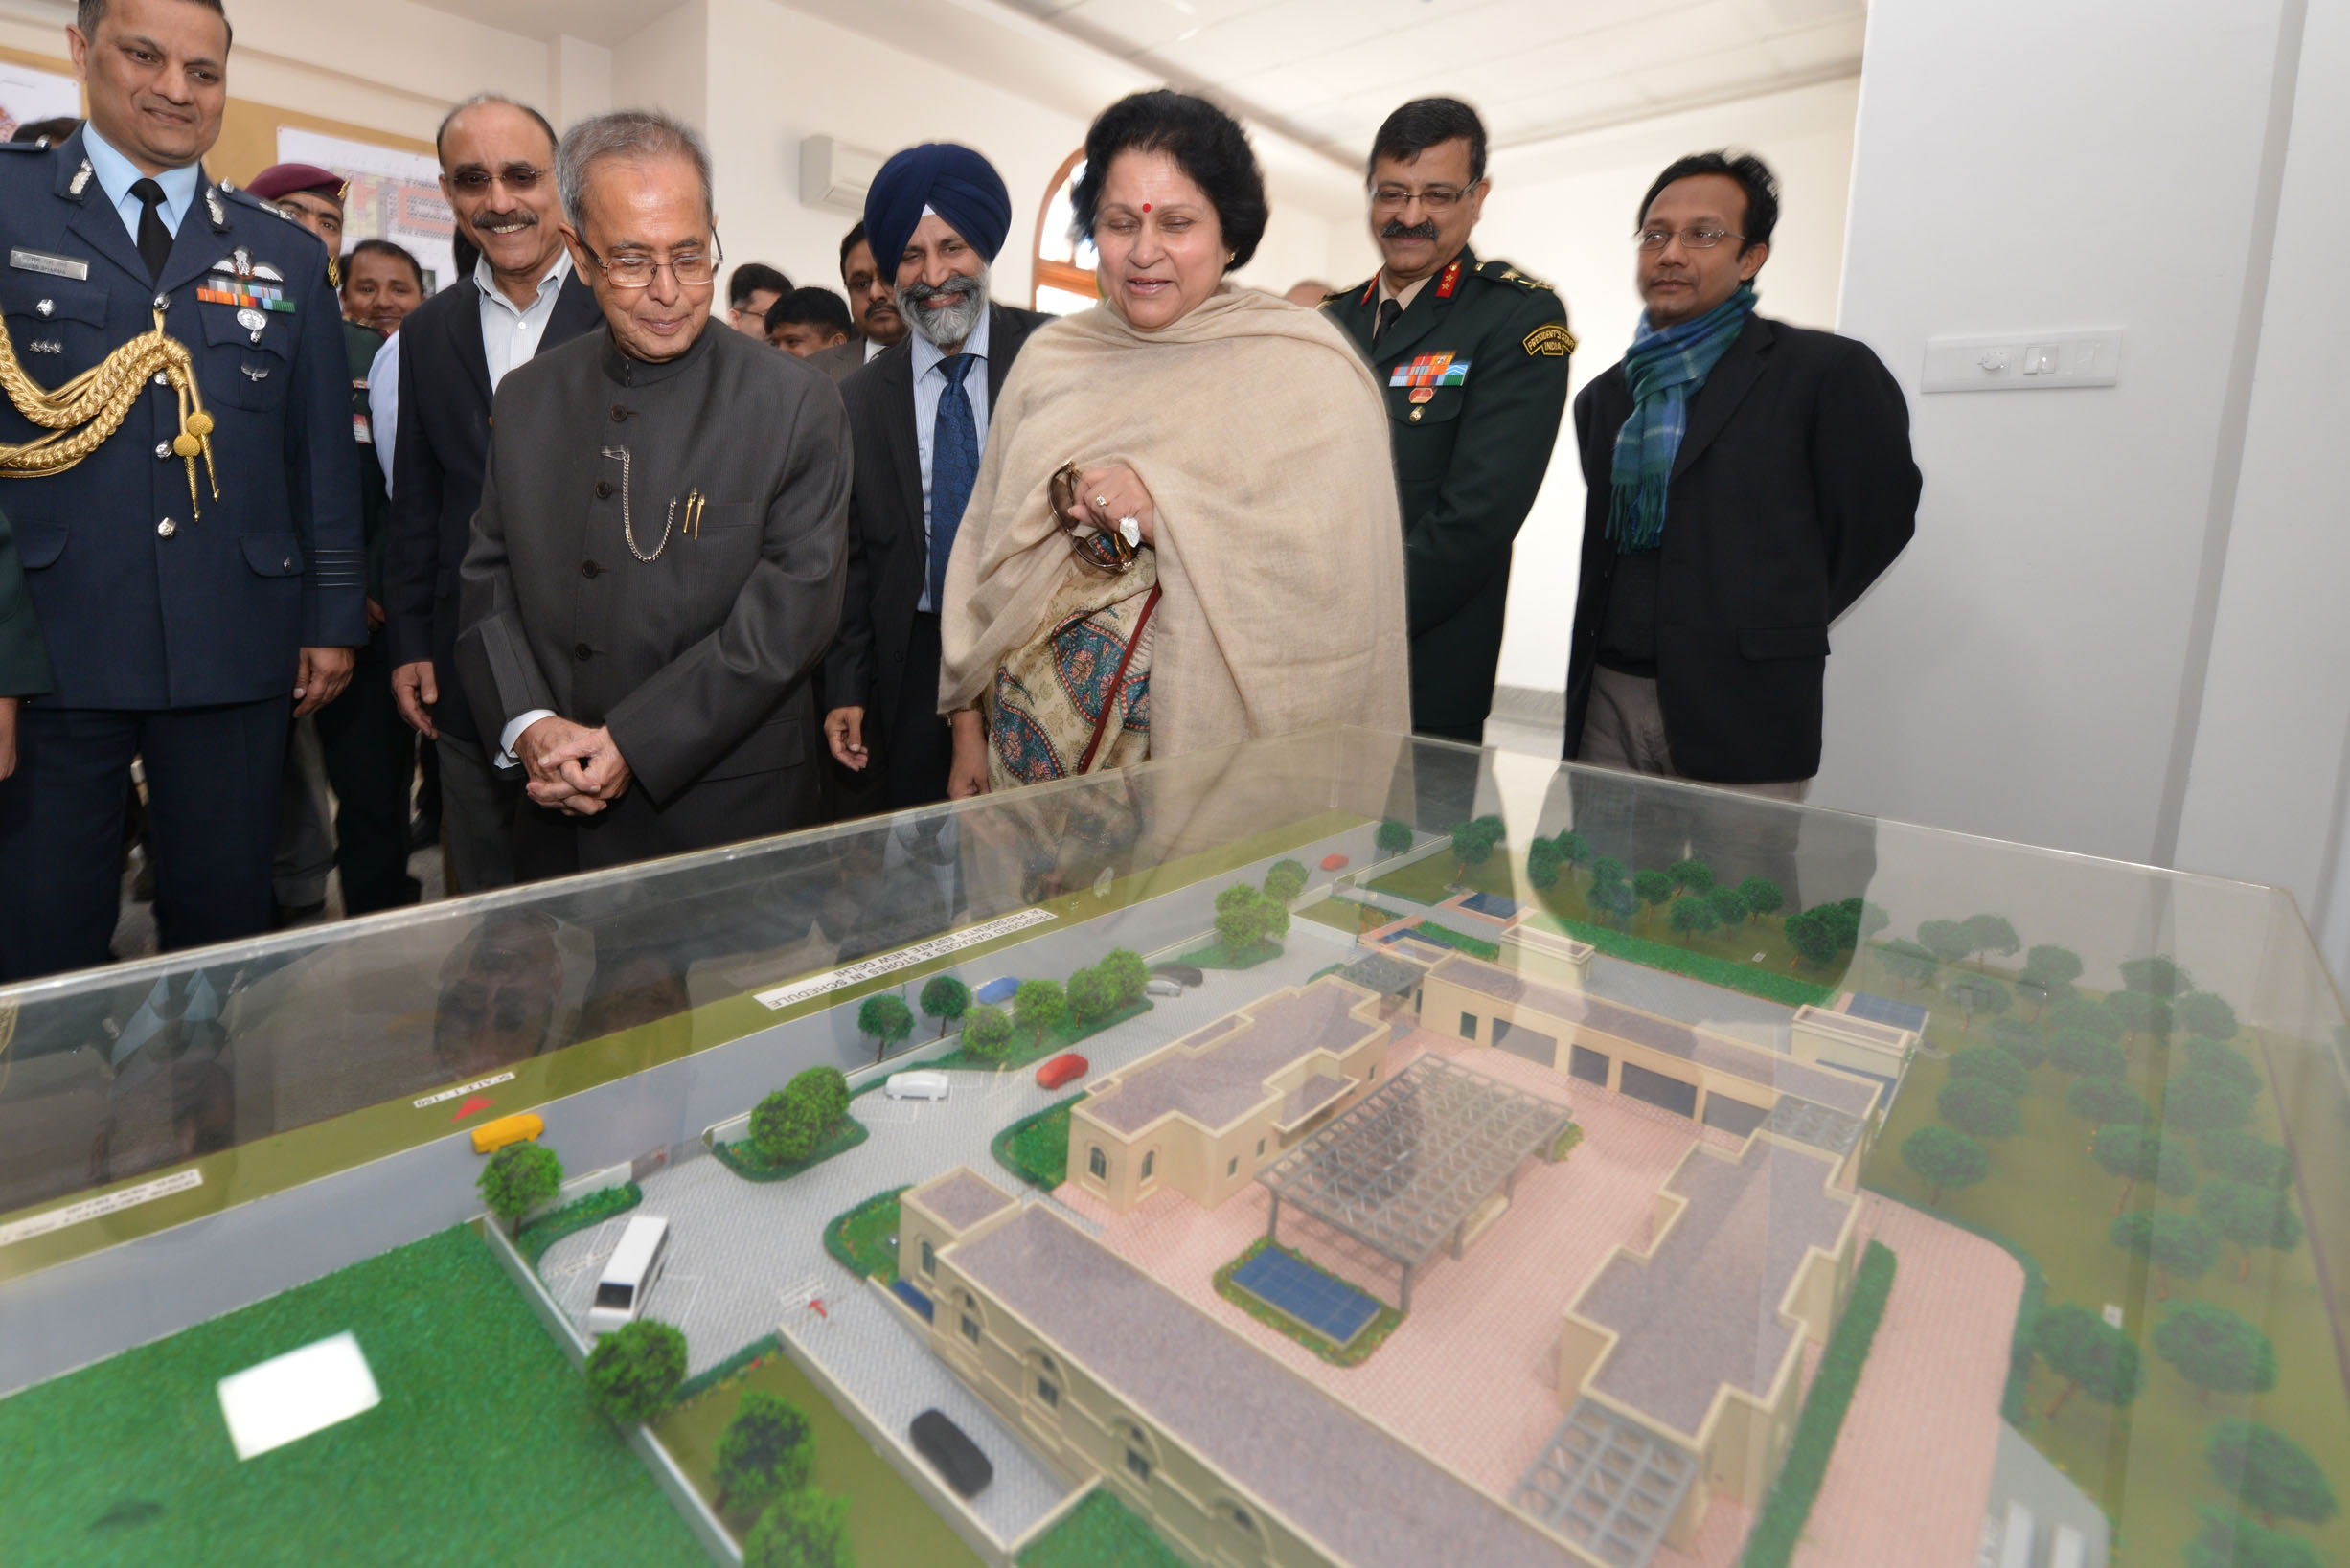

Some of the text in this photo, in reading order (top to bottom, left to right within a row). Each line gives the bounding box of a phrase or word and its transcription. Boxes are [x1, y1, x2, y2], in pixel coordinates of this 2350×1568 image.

[1527, 330, 1575, 351] PRESIDENT'S STAFF
[1544, 341, 1562, 351] INDIA
[954, 913, 1030, 939] PRESIDENT'S
[908, 936, 956, 953] ESTATE
[766, 913, 1056, 1007] PROPOSED GARAGES & STORES IN SCHEDULE
[876, 951, 909, 964] NEW
[832, 961, 877, 977] DELHI
